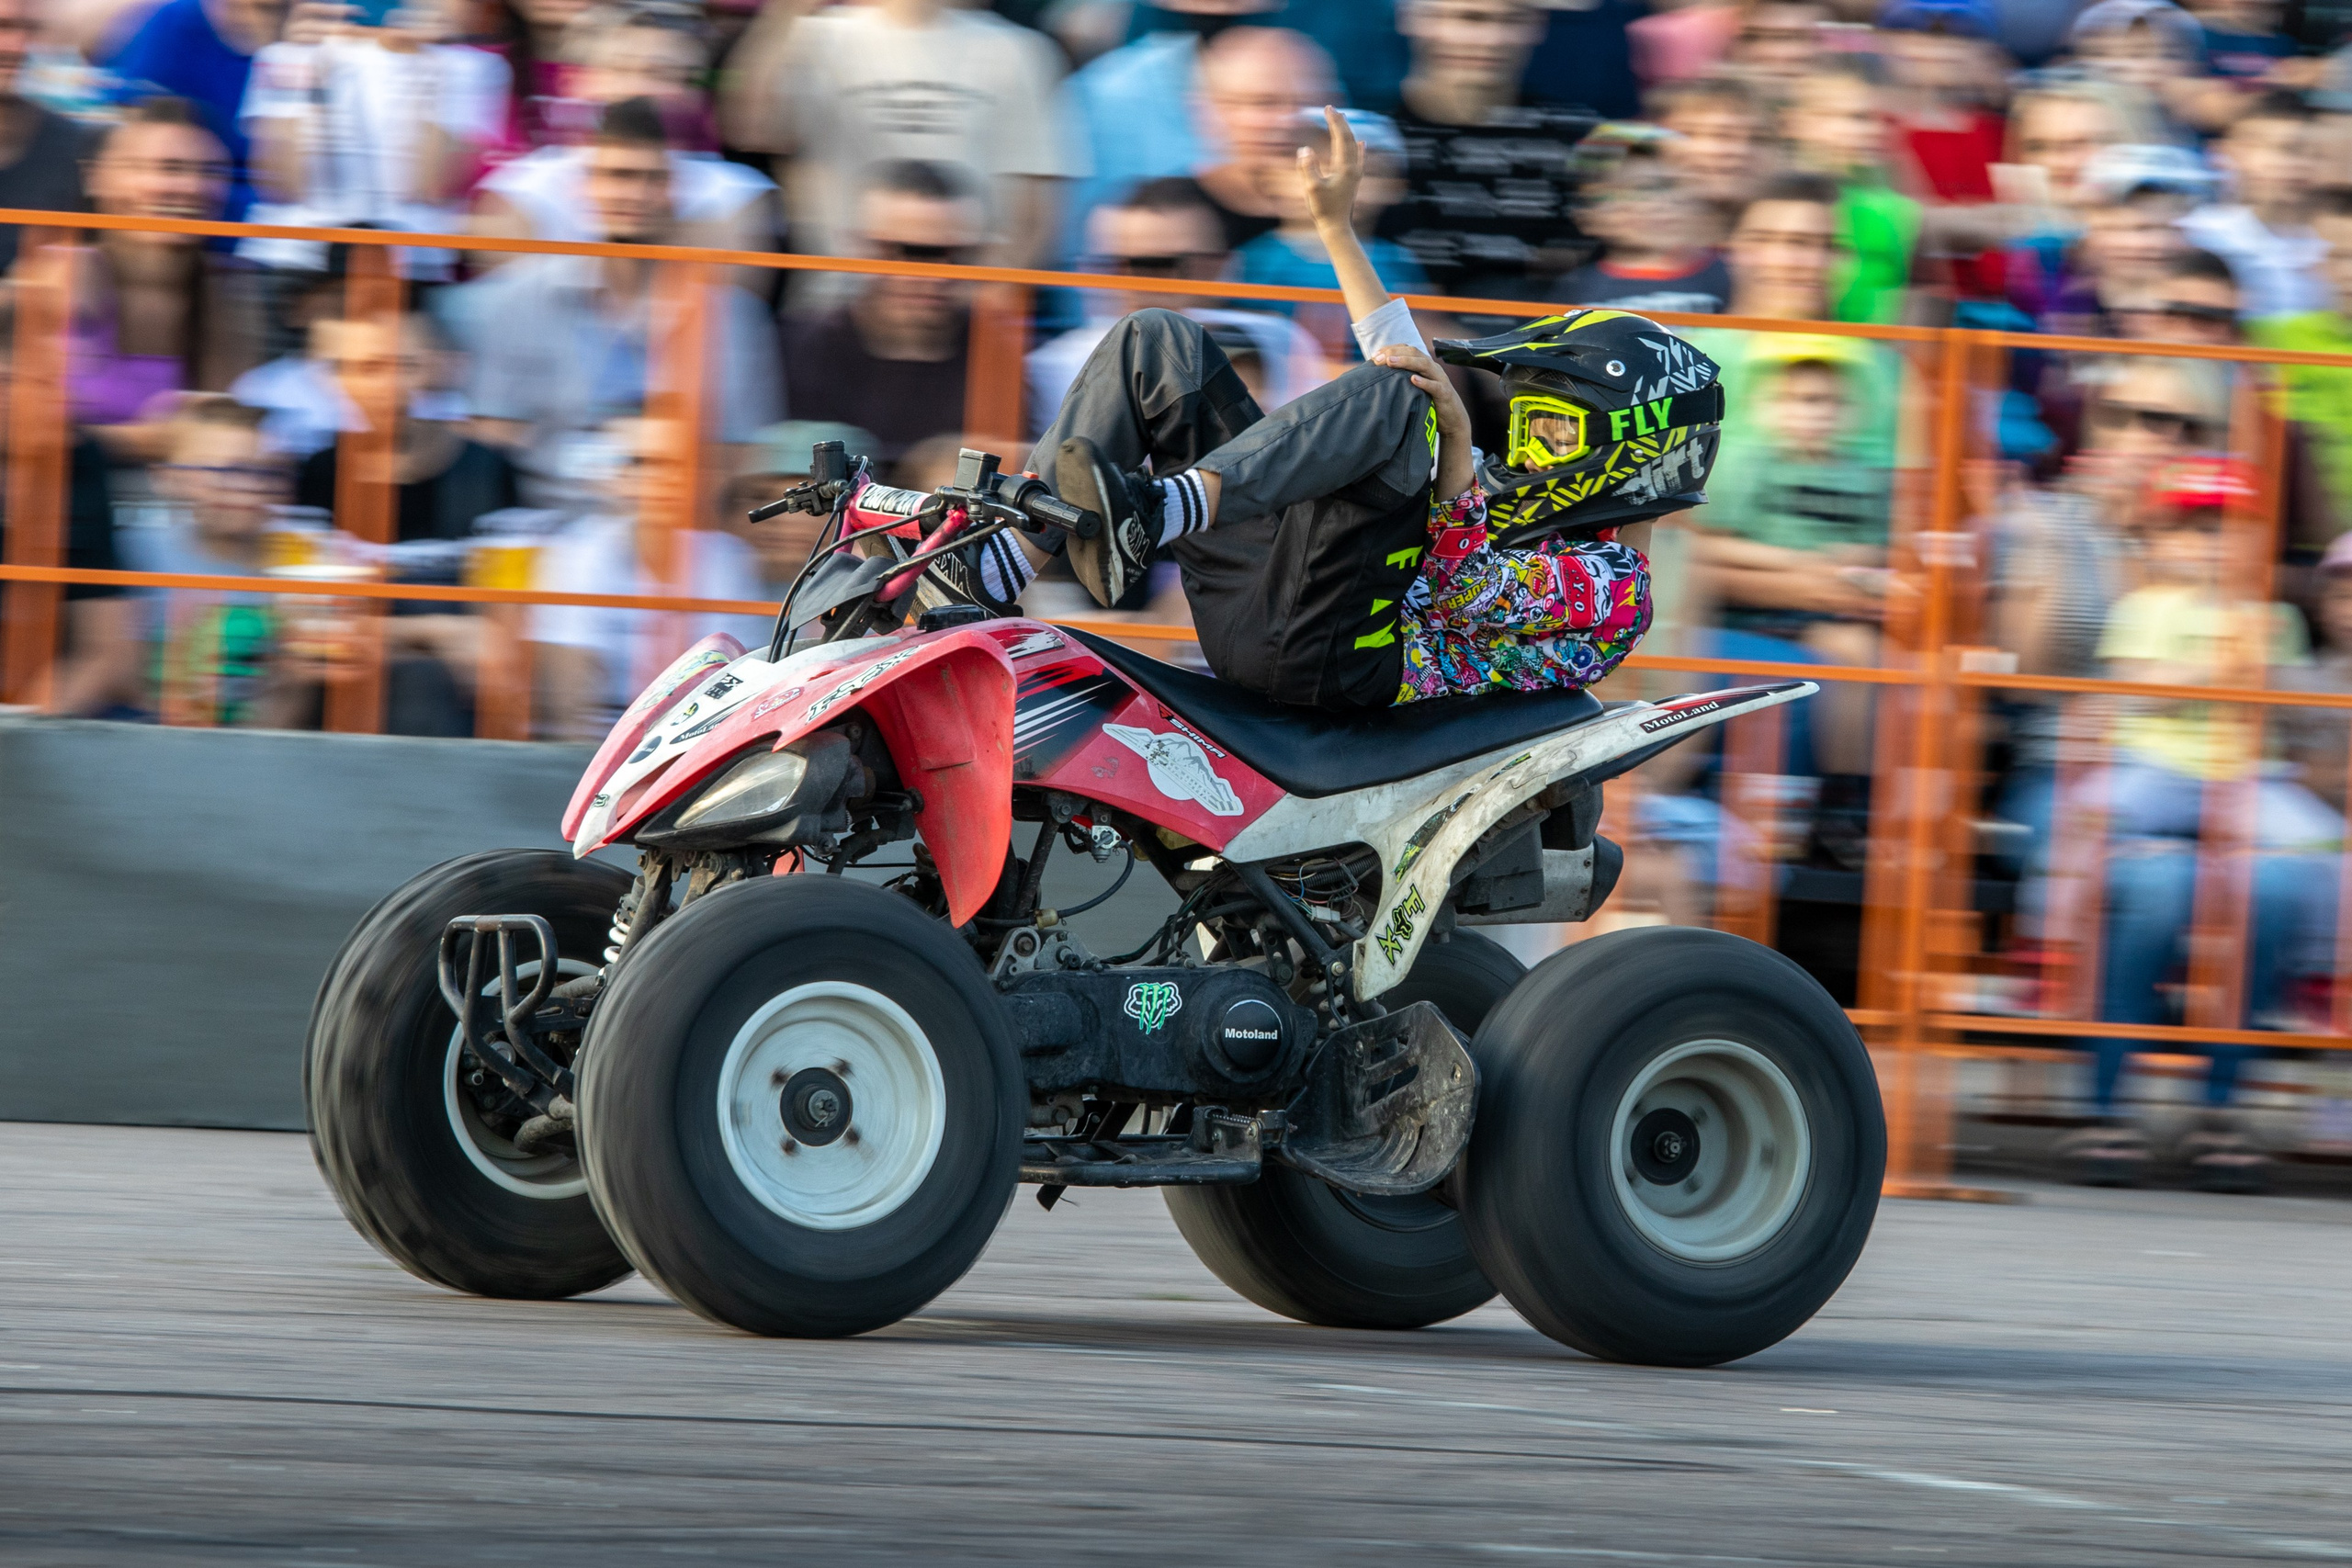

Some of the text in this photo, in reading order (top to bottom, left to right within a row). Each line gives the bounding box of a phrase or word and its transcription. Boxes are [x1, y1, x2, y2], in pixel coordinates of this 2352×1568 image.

[1608, 397, 1673, 441] FLY
[1445, 578, 1488, 611] SUPER
[1643, 700, 1720, 732] MotoLand
[1169, 718, 1227, 759] SHIMA
[1225, 1027, 1278, 1041] Motoland
